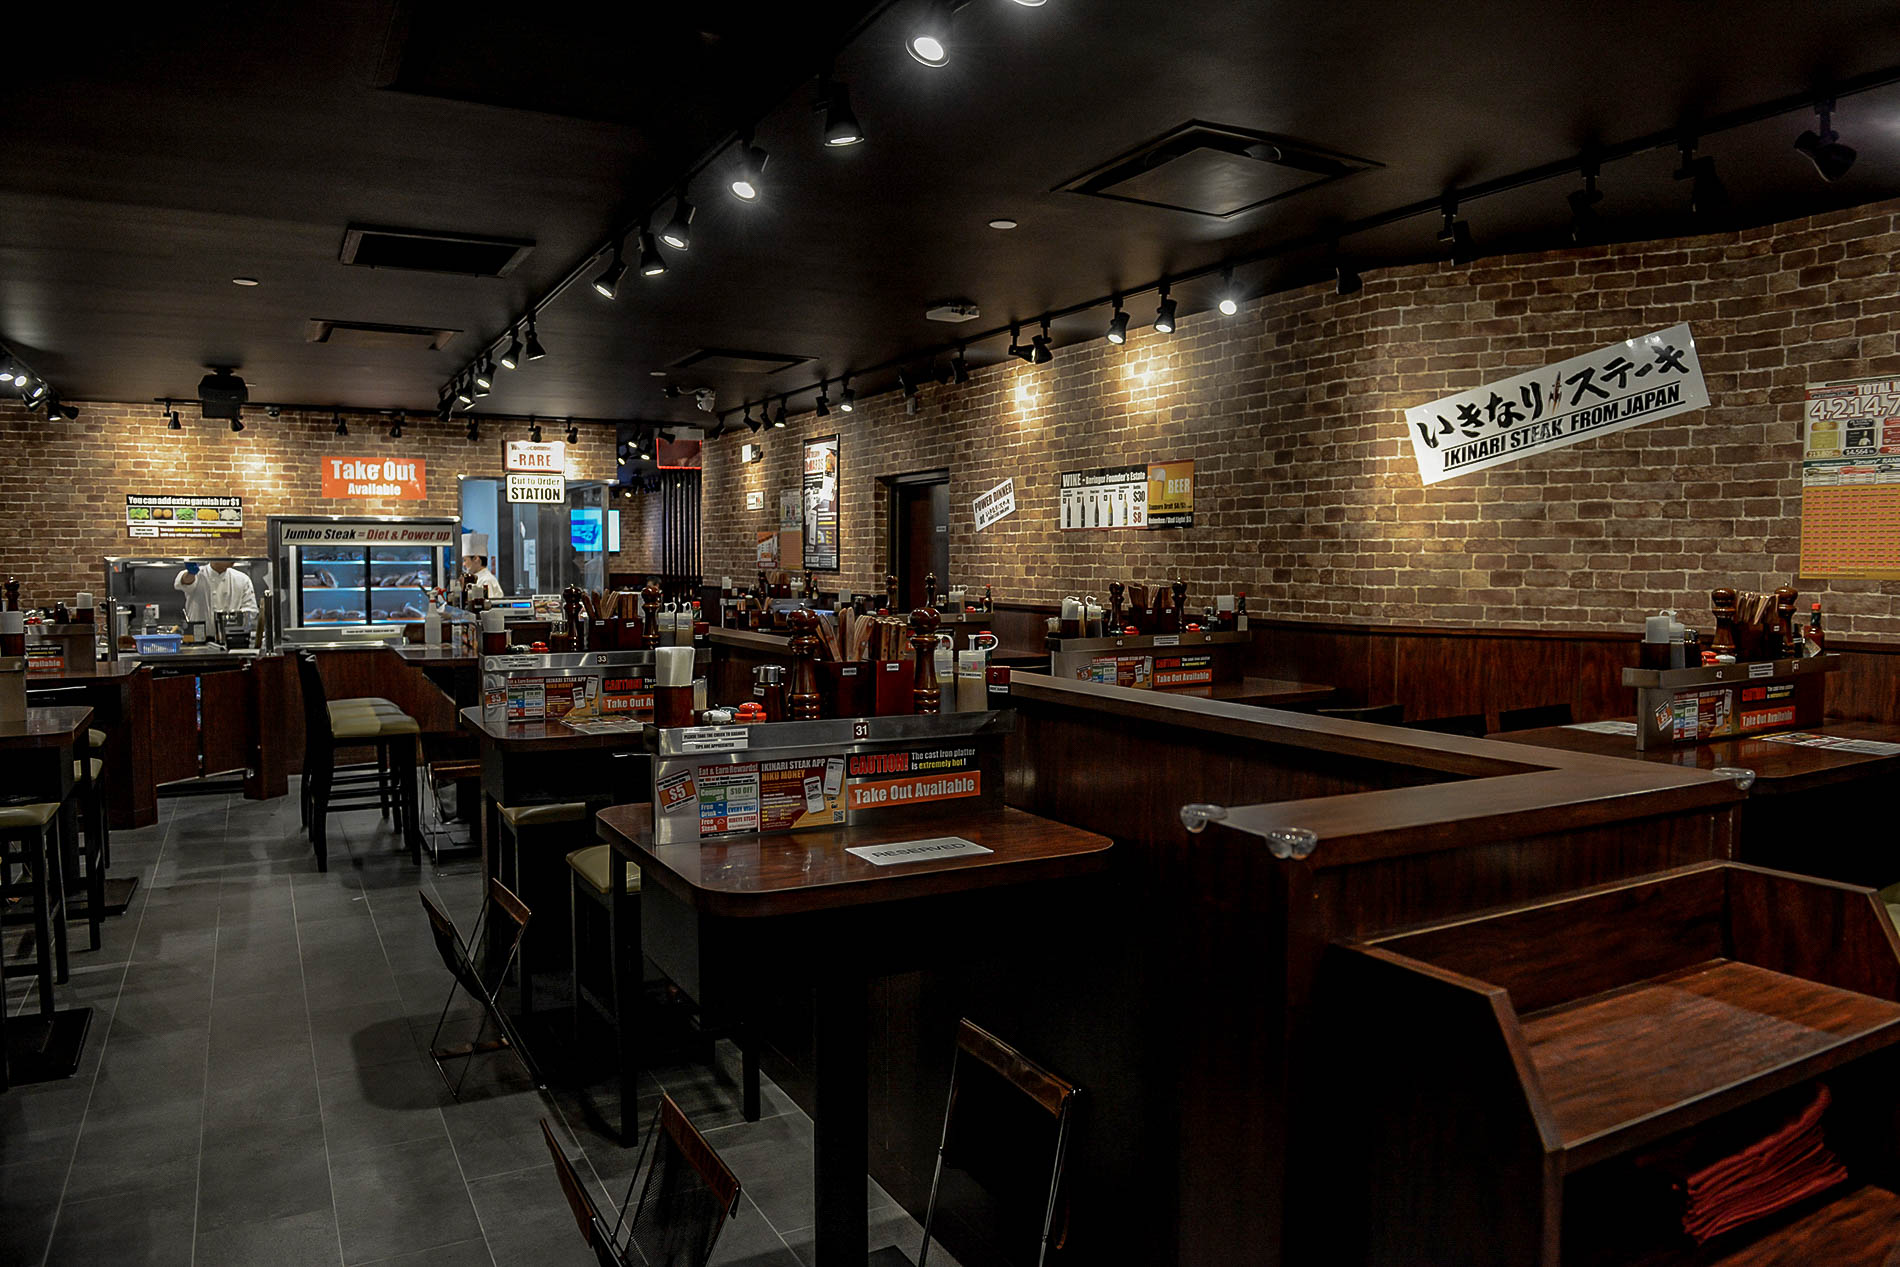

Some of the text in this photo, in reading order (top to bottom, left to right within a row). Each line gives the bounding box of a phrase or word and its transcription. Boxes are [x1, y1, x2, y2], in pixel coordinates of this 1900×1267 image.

[1444, 383, 1681, 468] IKINARI STEAK FROM JAPAN
[330, 460, 417, 481] Take Out
[511, 476, 560, 486] Cut to Order
[1063, 473, 1082, 488] WINE
[1168, 478, 1190, 494] BEER
[347, 483, 402, 496] Available
[511, 487, 561, 501] STATION
[128, 496, 142, 504] You
[191, 498, 219, 506] garnish
[230, 498, 240, 506] $1
[1133, 490, 1146, 503] $30
[1132, 511, 1142, 523] $8
[284, 528, 323, 540] Jumbo
[324, 528, 356, 540] Steak
[366, 529, 389, 541] Diet
[390, 530, 398, 540] &
[400, 529, 435, 541] Power
[437, 530, 451, 542] up
[1157, 671, 1210, 683] Take Out Available
[604, 678, 643, 691] CAUTION!
[606, 698, 628, 709] Take
[630, 697, 645, 708] Out
[856, 726, 869, 737] 31
[761, 758, 826, 772] IKINARI STEAK APP
[850, 748, 976, 775] CAUTION! The cast iron platter
[911, 762, 918, 770] is
[918, 759, 951, 770] extremely
[951, 758, 963, 767] hot
[699, 766, 709, 775] Eat
[761, 769, 806, 781] NIKU MONEY
[668, 784, 687, 801] $5
[730, 787, 740, 796] $10
[741, 786, 753, 794] OFF
[854, 777, 975, 804] Take Out Available
[872, 842, 967, 858] RESERVED
